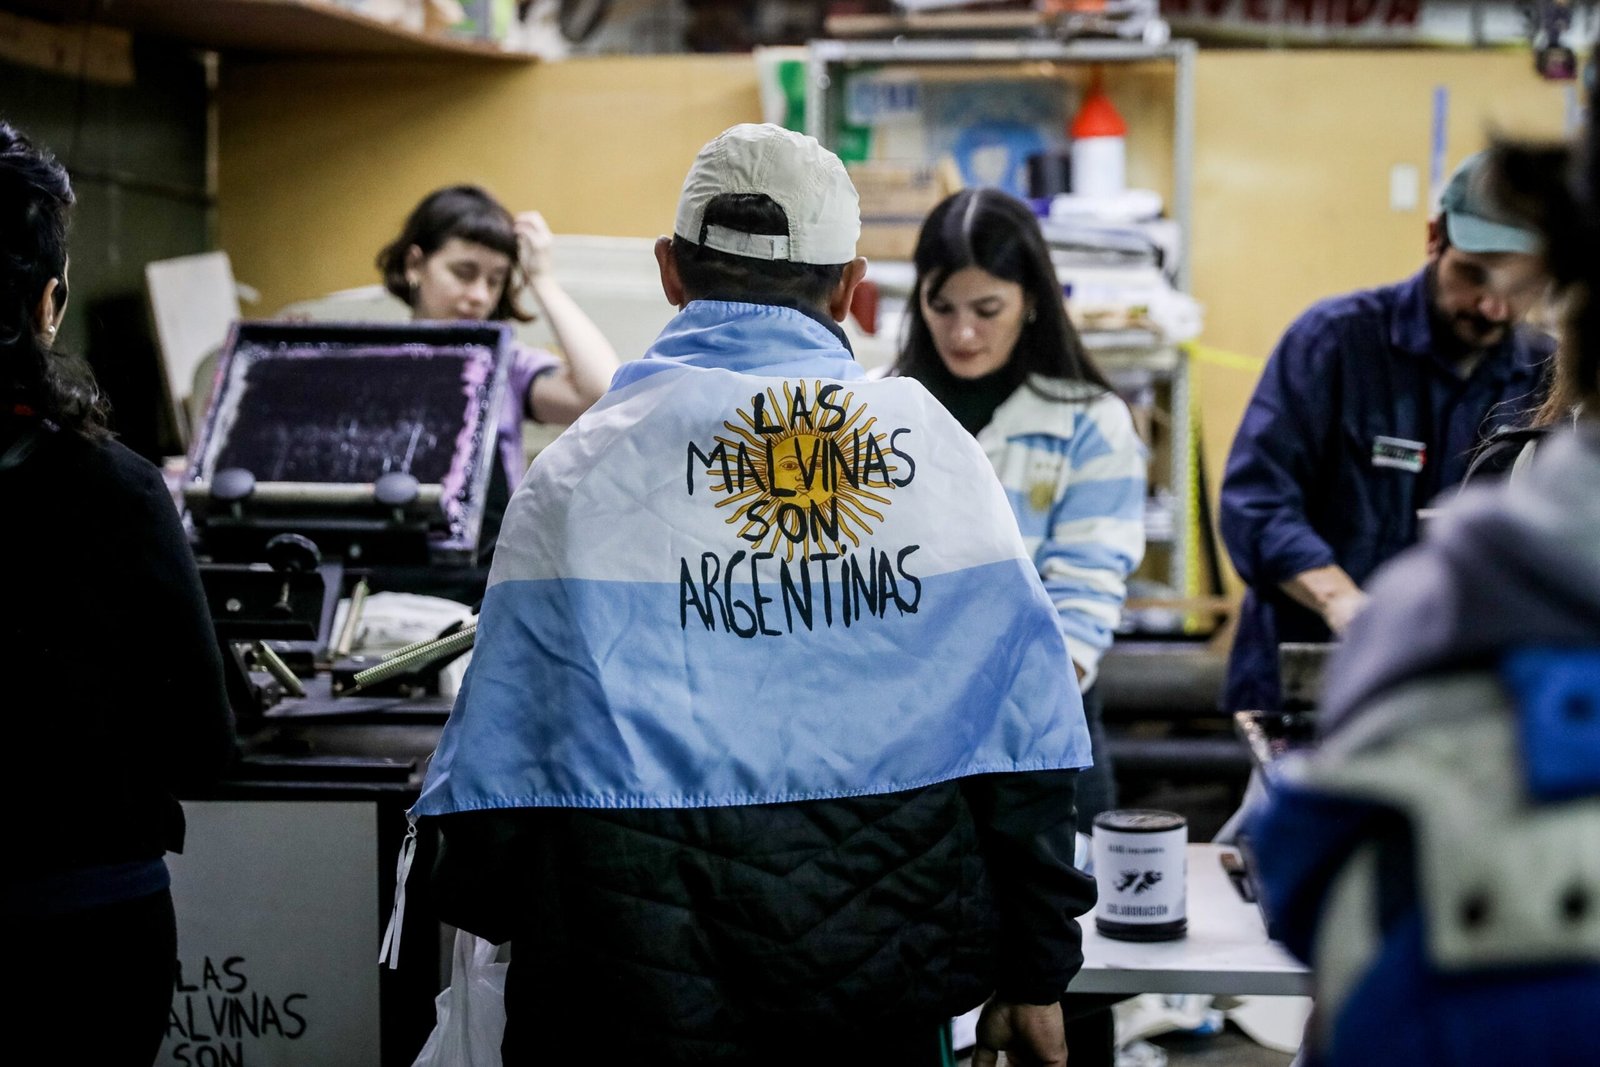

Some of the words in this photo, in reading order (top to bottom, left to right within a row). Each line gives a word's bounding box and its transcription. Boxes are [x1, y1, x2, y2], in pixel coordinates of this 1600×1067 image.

[753, 383, 847, 434] LAS
[686, 427, 916, 497] MALVINAS
[741, 496, 839, 543] SON
[175, 956, 247, 994] LAS
[165, 991, 308, 1040] ALVINAS
[172, 1041, 244, 1067] SON
